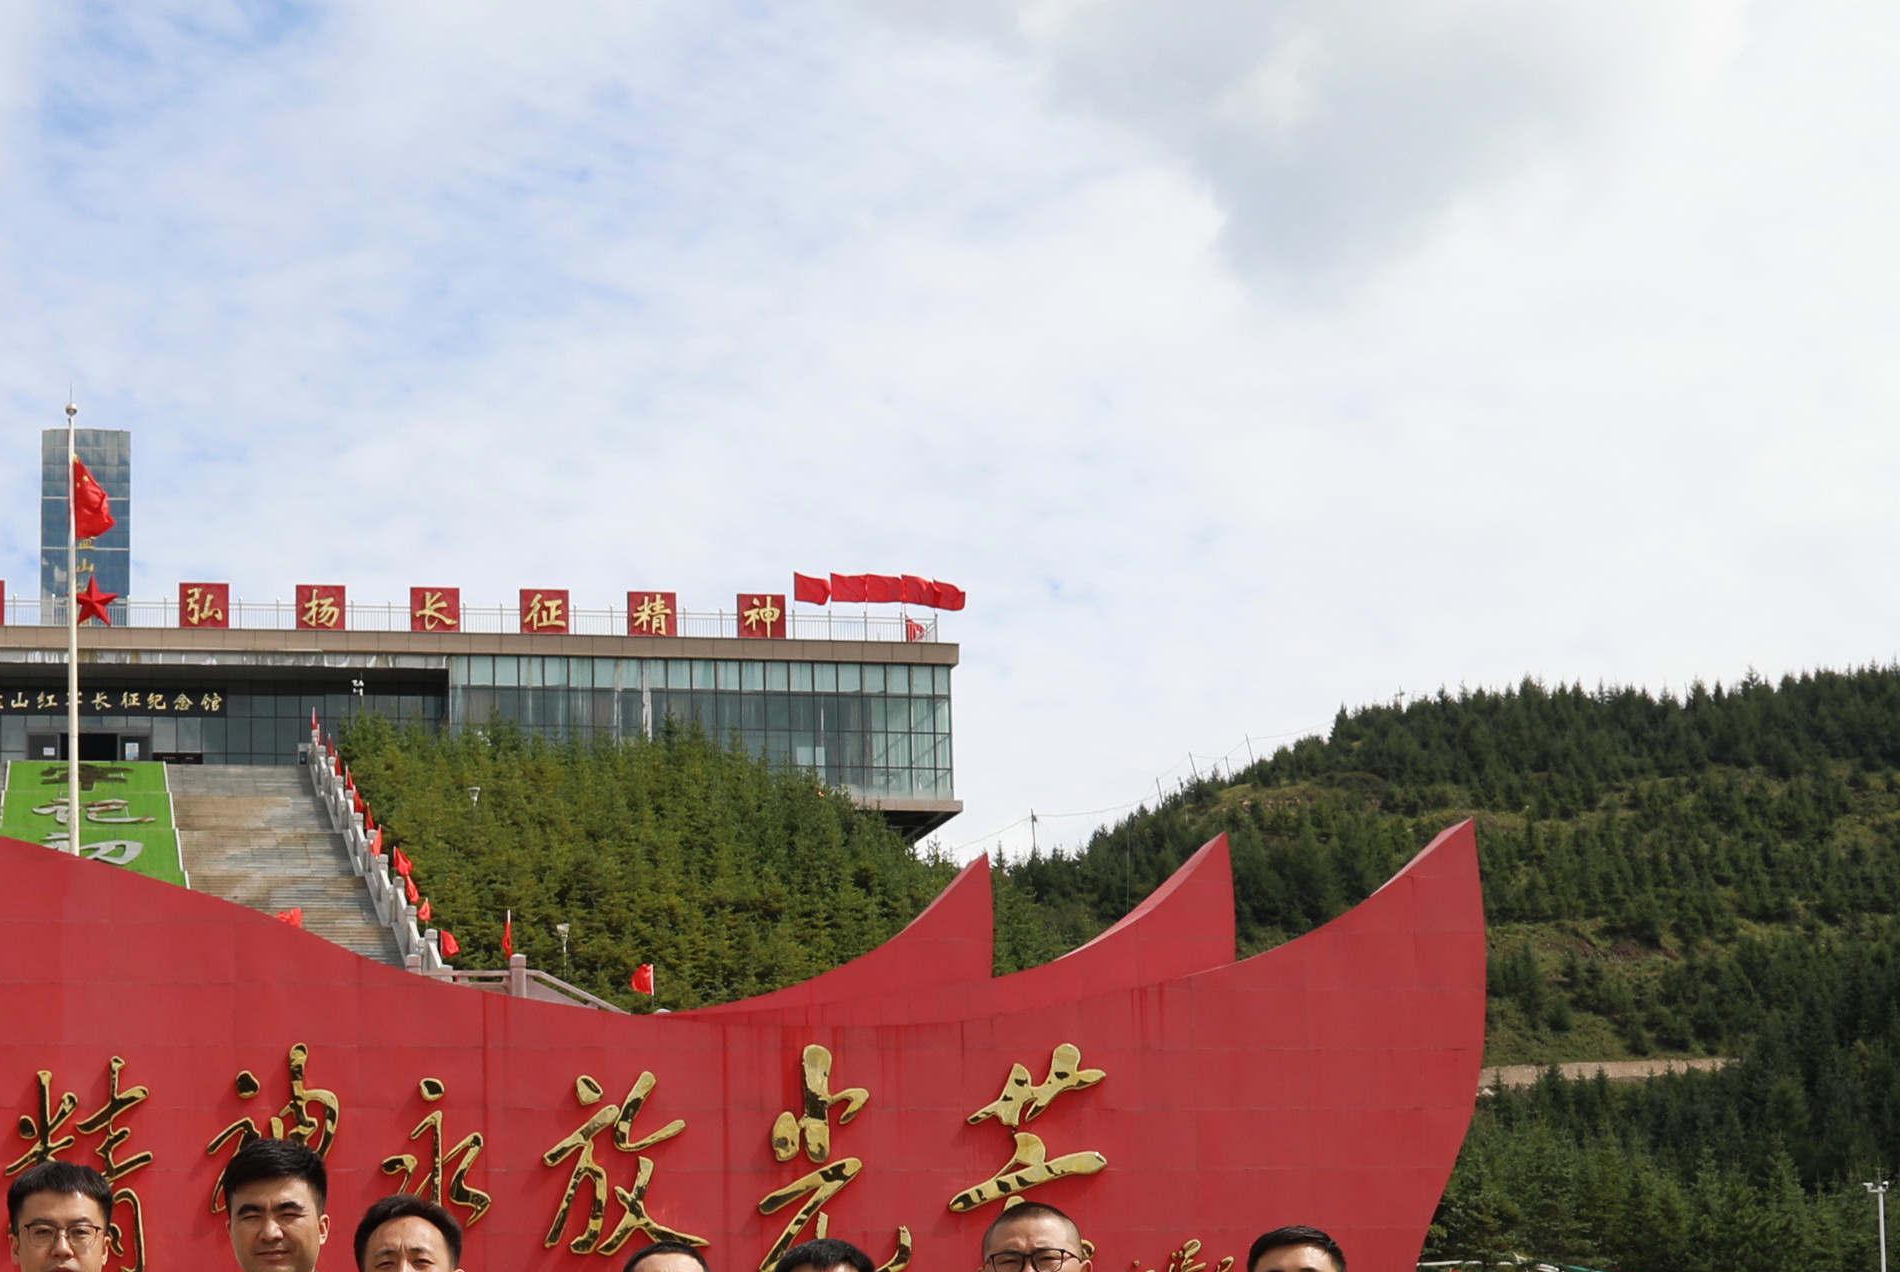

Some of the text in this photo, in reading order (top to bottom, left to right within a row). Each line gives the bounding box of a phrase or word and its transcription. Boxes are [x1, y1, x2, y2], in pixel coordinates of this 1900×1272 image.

[185, 586, 784, 637] 弘扬长征精神
